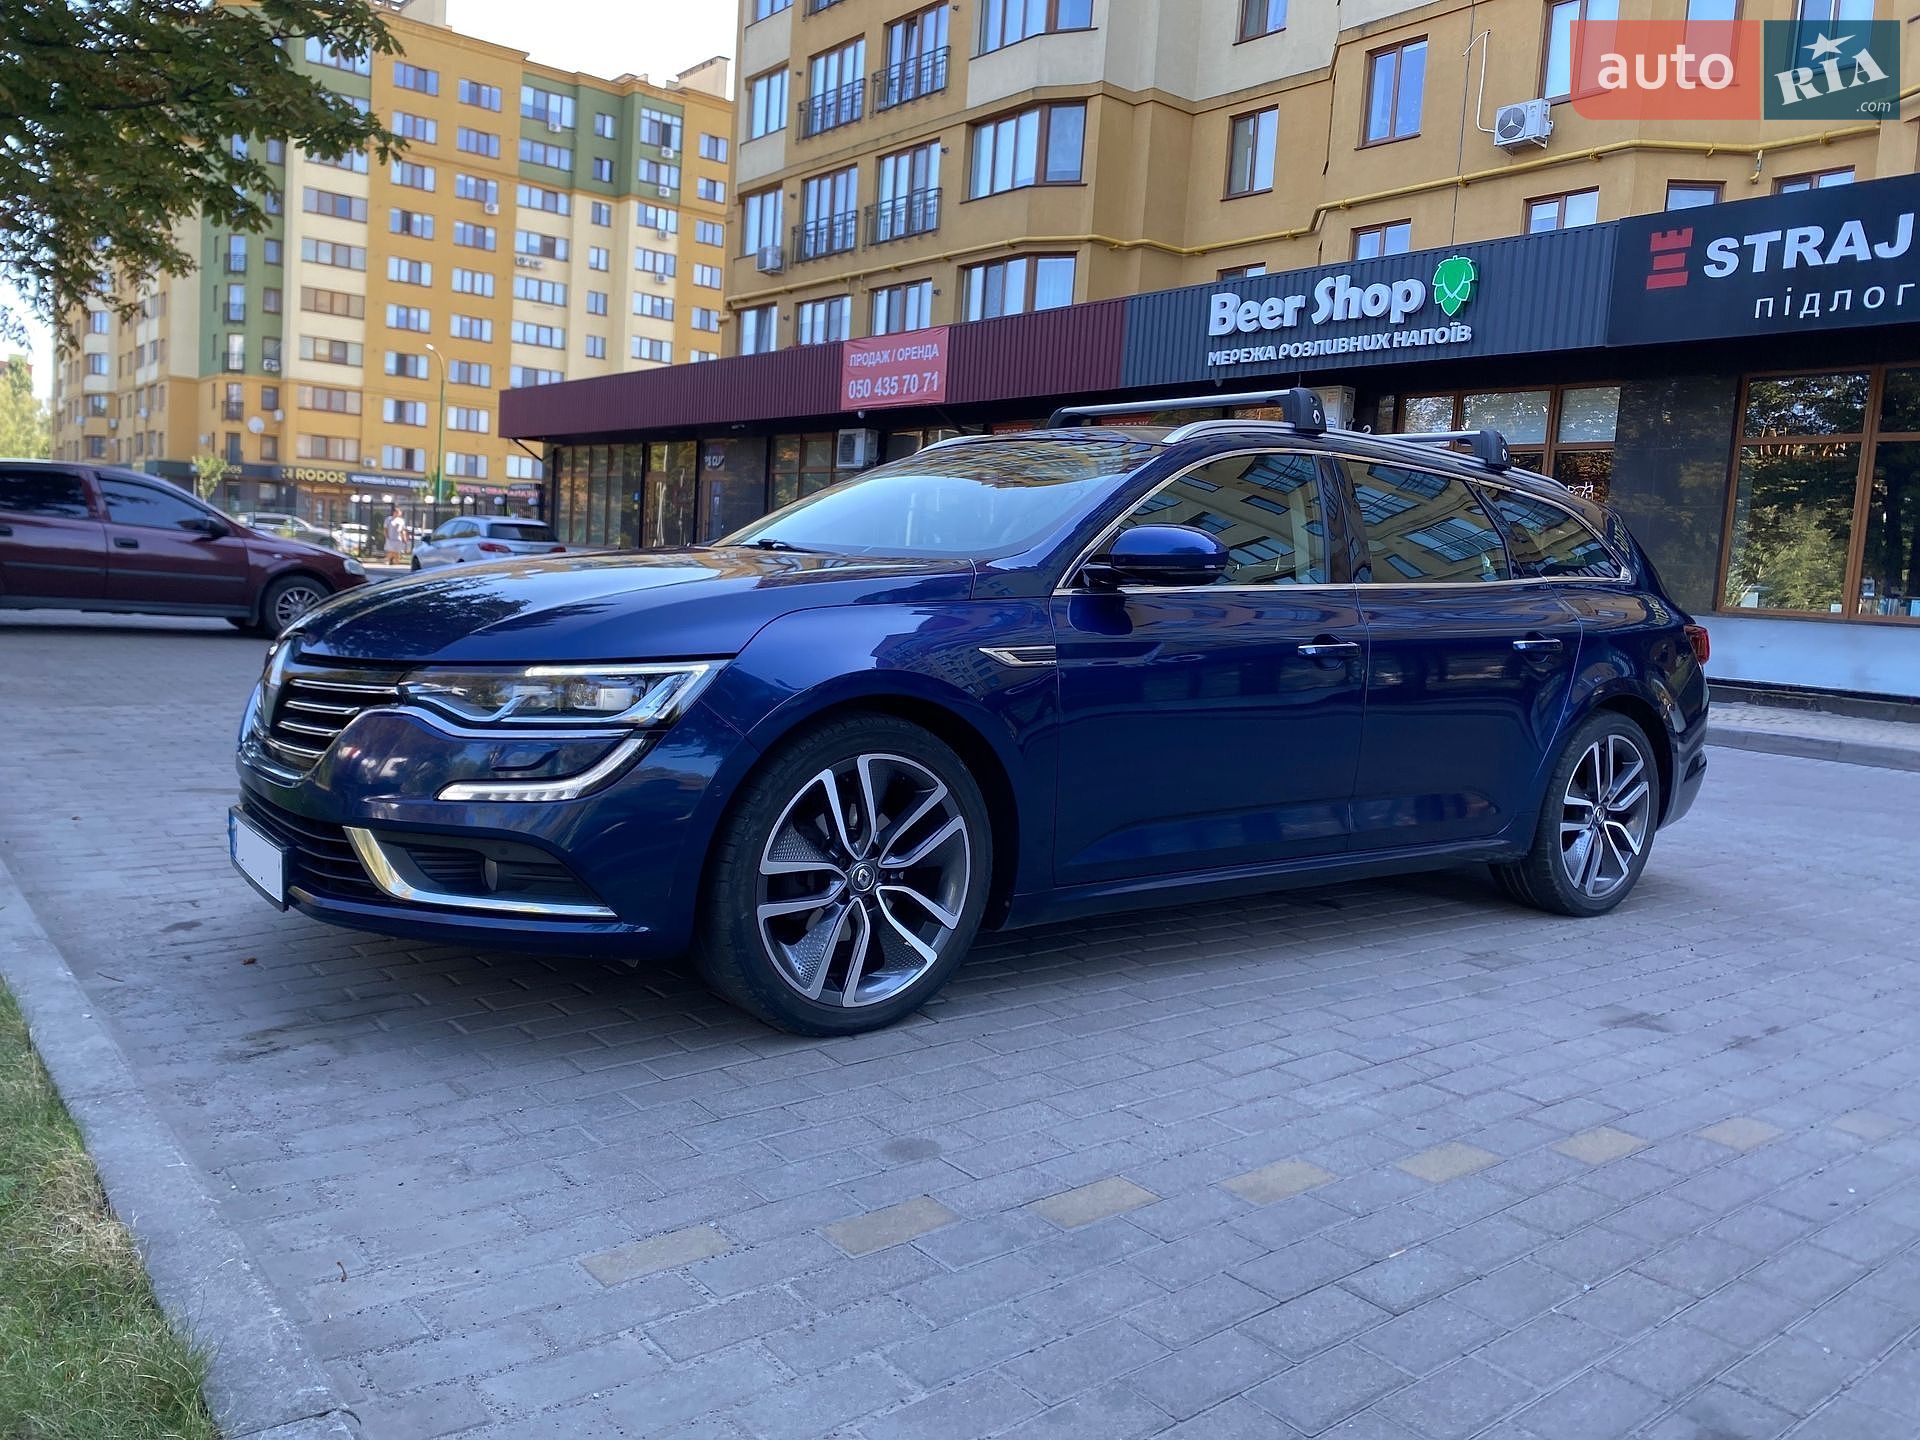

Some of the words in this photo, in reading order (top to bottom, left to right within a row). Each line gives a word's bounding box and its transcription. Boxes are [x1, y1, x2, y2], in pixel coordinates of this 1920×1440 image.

[1703, 212, 1915, 278] STRAJ
[1208, 292, 1306, 336] Beer
[1311, 274, 1427, 325] Shop
[1754, 283, 1916, 319] підлог
[849, 348, 891, 367] ПРОДАЖ
[897, 343, 940, 361] ОРЕНДА
[1207, 344, 1278, 367] МЕРЕЖА
[1278, 332, 1392, 360] РОЗЛИВНИХ
[1393, 321, 1473, 349] НАПОЇВ
[848, 378, 871, 399] 050
[874, 376, 899, 396] 435
[902, 374, 919, 394] 70
[923, 370, 939, 392] 71
[295, 467, 347, 484] RODOS
